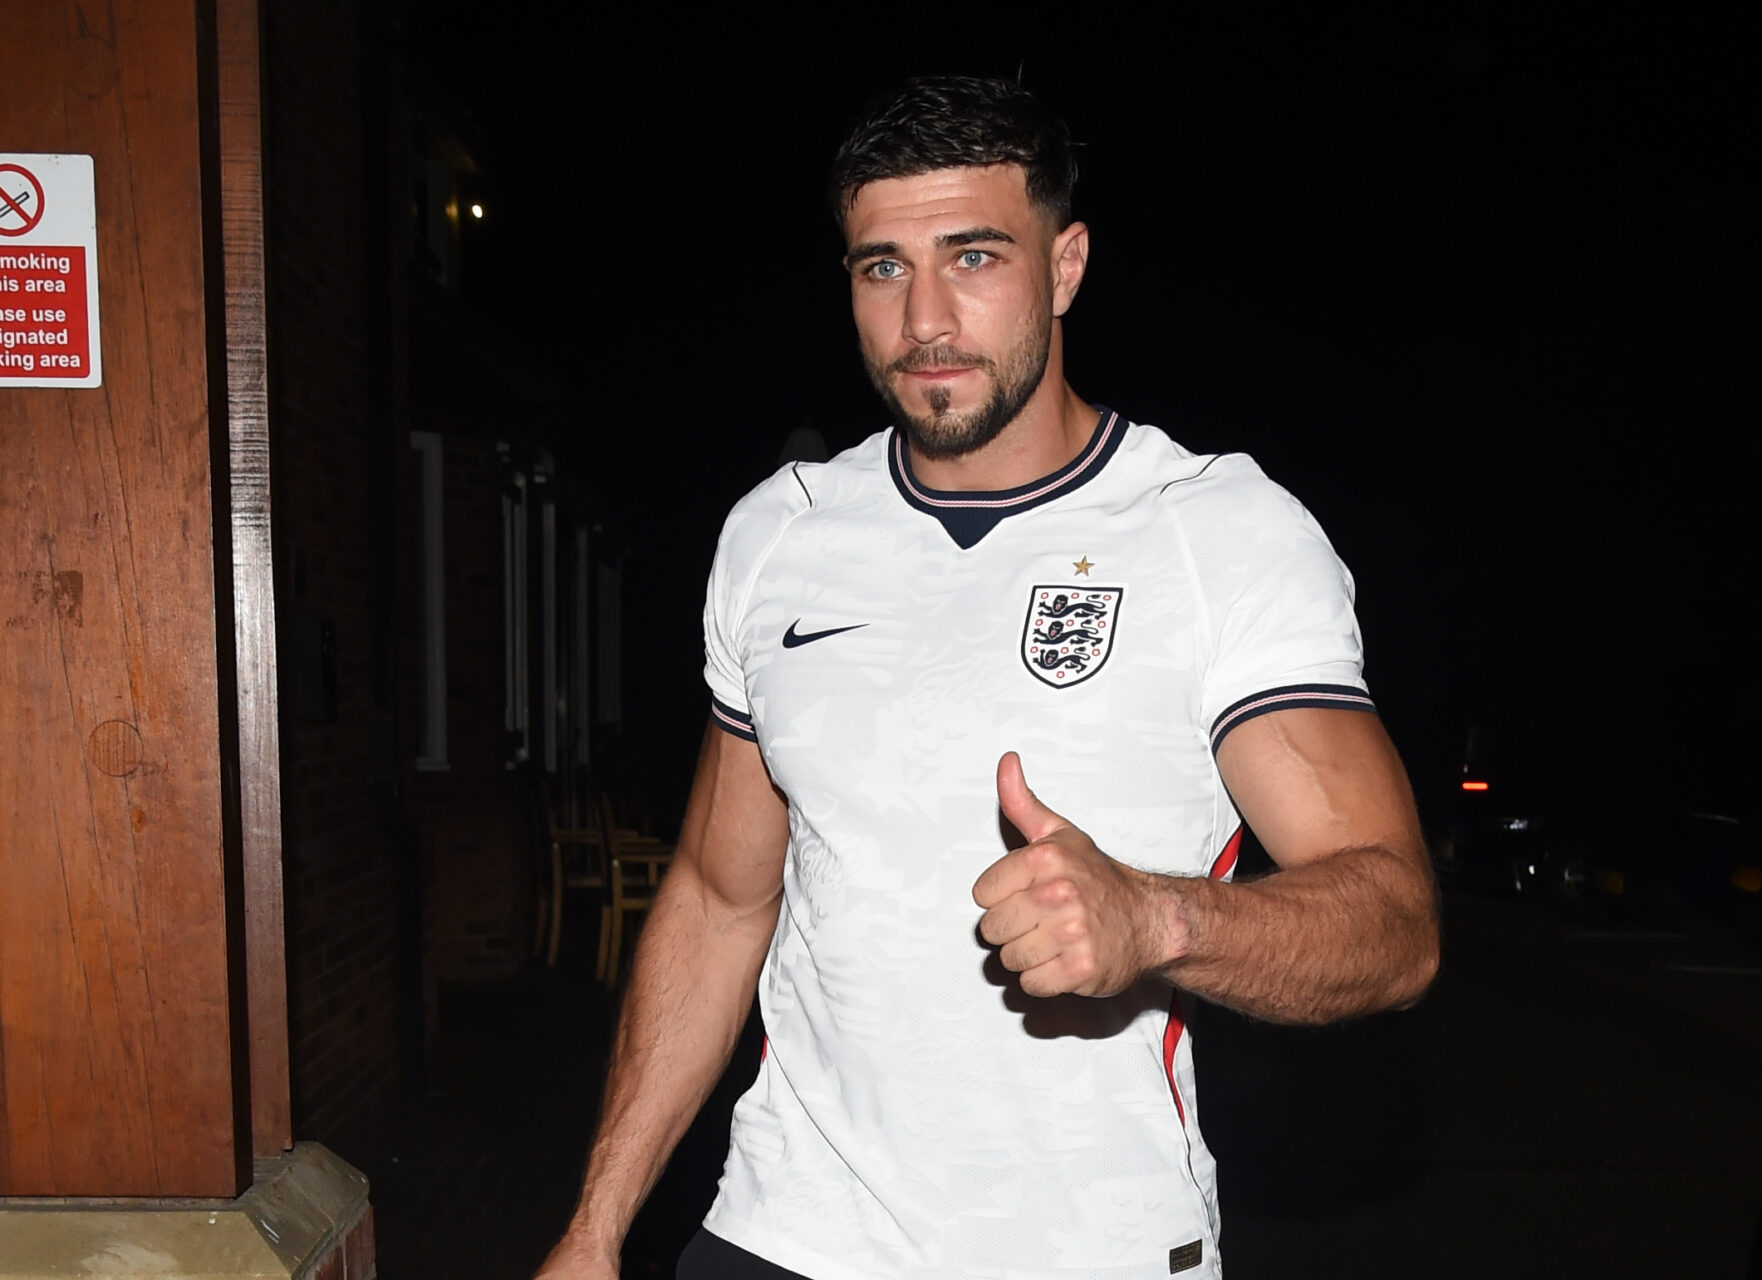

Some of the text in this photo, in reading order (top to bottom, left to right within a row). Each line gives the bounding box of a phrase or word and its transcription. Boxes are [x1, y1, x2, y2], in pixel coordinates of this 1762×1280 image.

[0, 253, 71, 274] moking
[0, 275, 66, 293] is area
[32, 309, 66, 323] use
[40, 353, 81, 368] area
